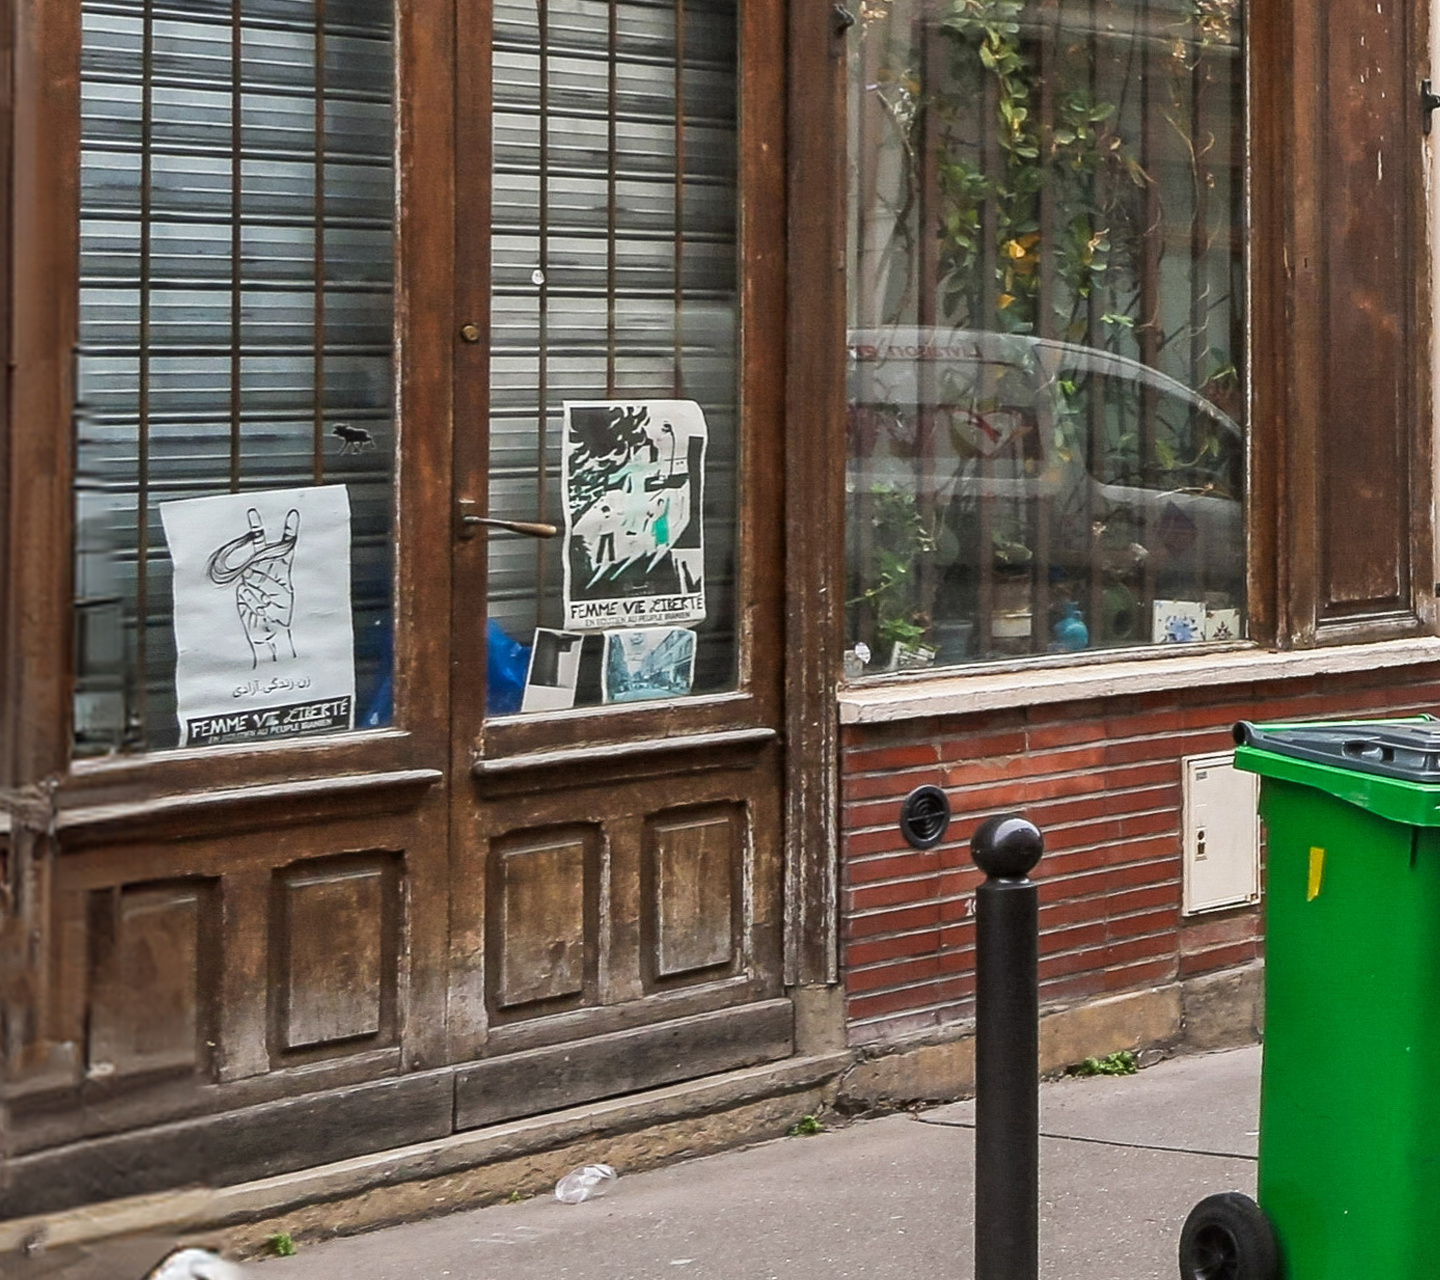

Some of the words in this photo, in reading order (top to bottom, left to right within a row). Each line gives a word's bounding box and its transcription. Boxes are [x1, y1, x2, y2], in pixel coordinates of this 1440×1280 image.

[571, 601, 619, 619] FEMME
[623, 600, 646, 614] VIE
[628, 615, 638, 623] AU
[638, 614, 663, 623] PEUPLE
[190, 715, 249, 738] FEMME
[253, 710, 280, 728] VIE
[283, 698, 349, 724] LIBERTÉ
[269, 723, 300, 734] PEUPLE
